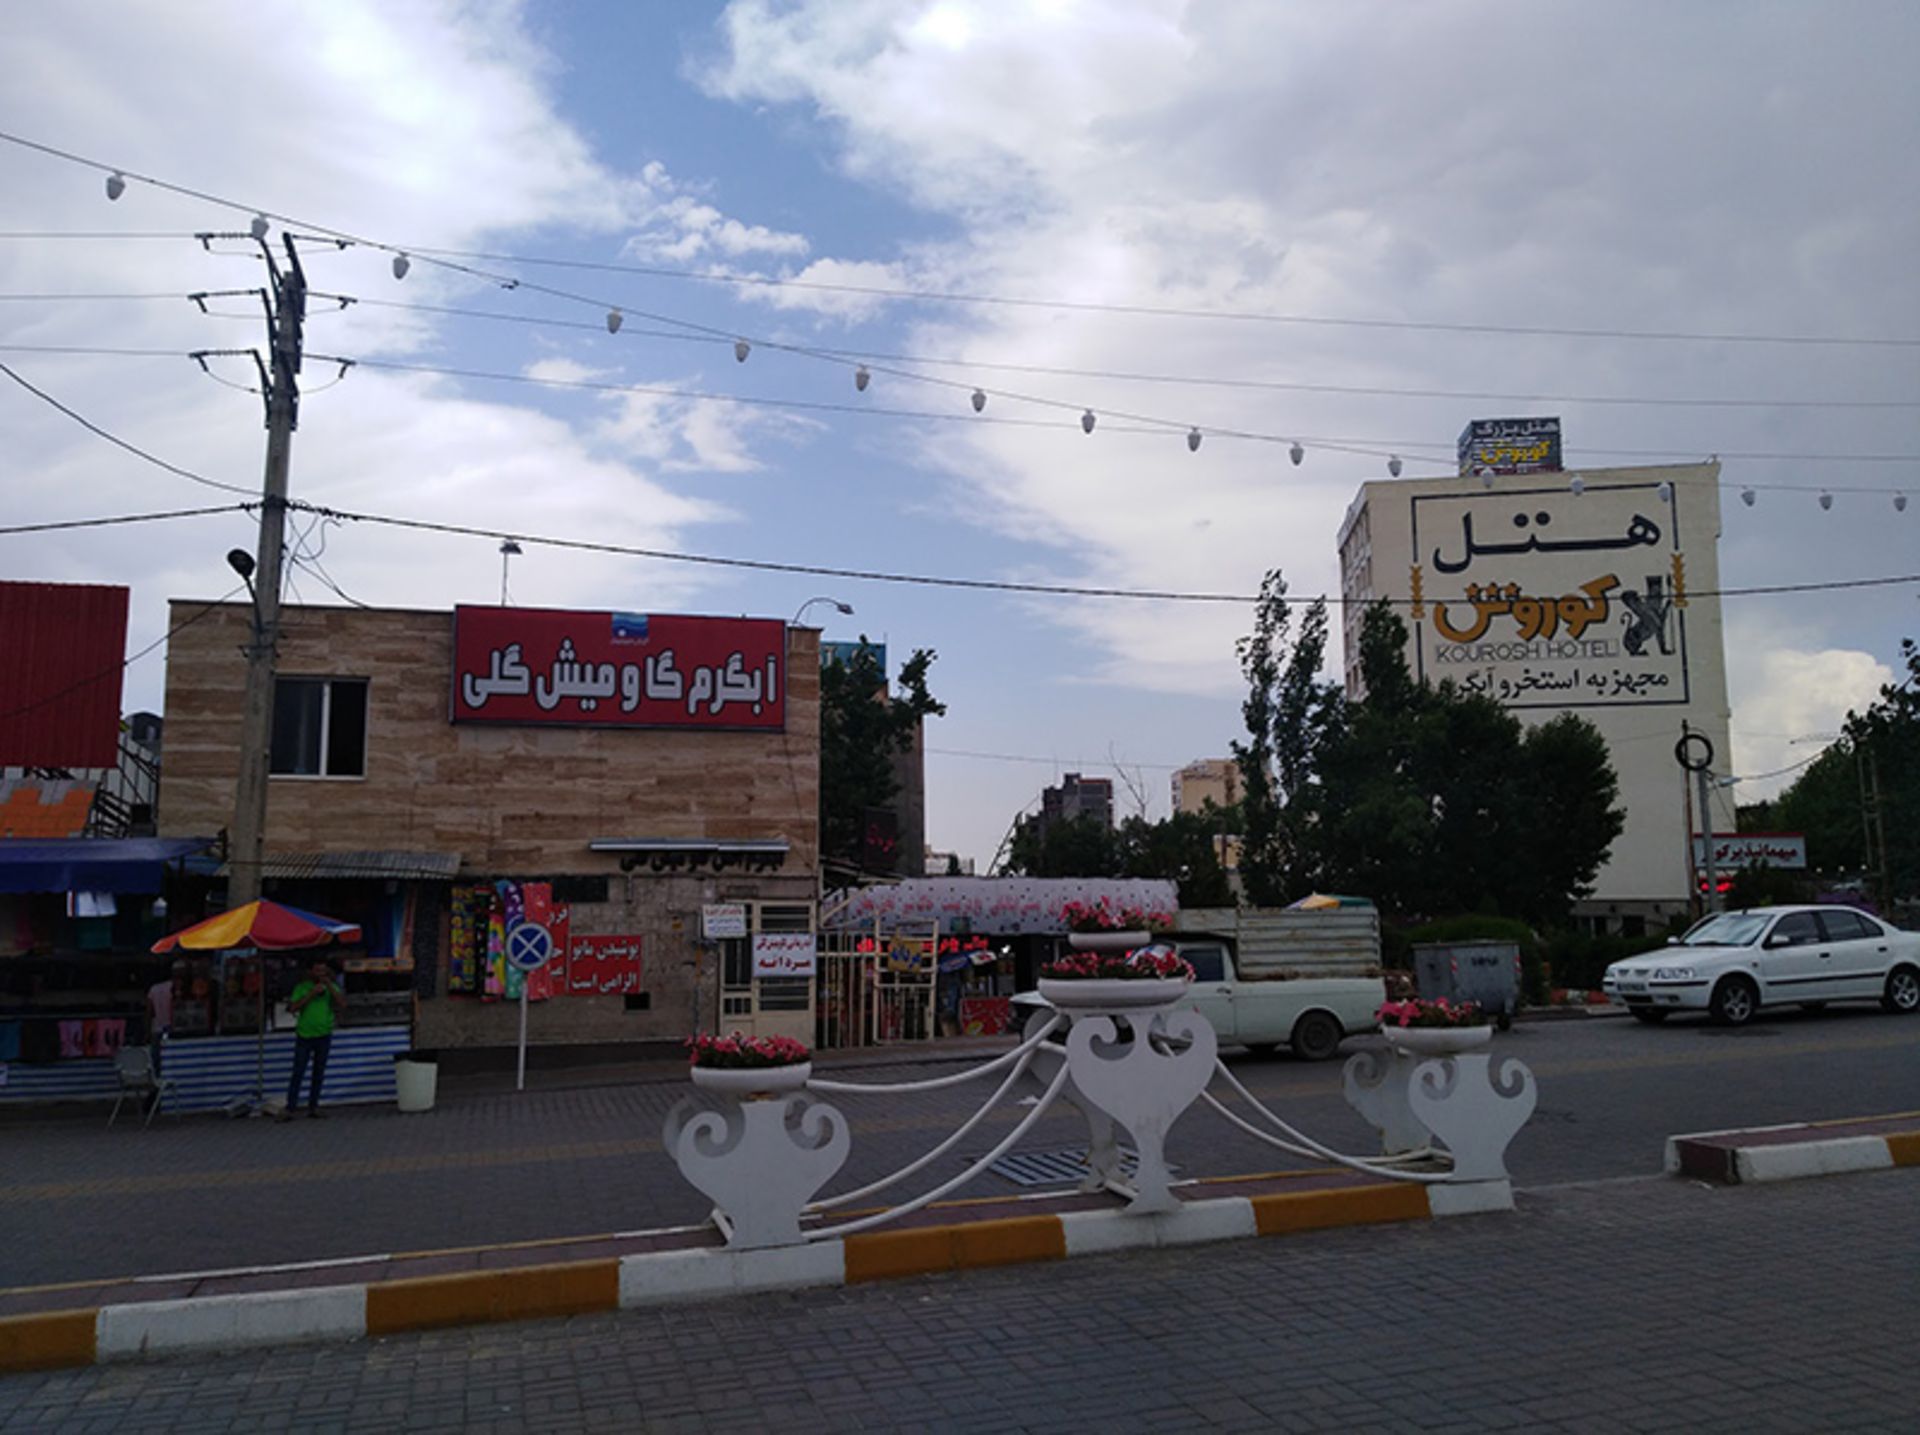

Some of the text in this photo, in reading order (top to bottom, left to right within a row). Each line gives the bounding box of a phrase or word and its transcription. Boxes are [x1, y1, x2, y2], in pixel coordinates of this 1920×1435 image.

[1433, 511, 1660, 573] هتل
[1434, 573, 1621, 643] کوروش
[1436, 639, 1620, 663] KOUROSH HOTEL
[462, 644, 531, 709] گلی
[688, 652, 776, 714] آبگرم
[1514, 669, 1580, 698] استخر
[1586, 672, 1607, 694] به
[1611, 669, 1669, 695] مجهز
[571, 971, 598, 989] است
[599, 971, 638, 993] الزامی
